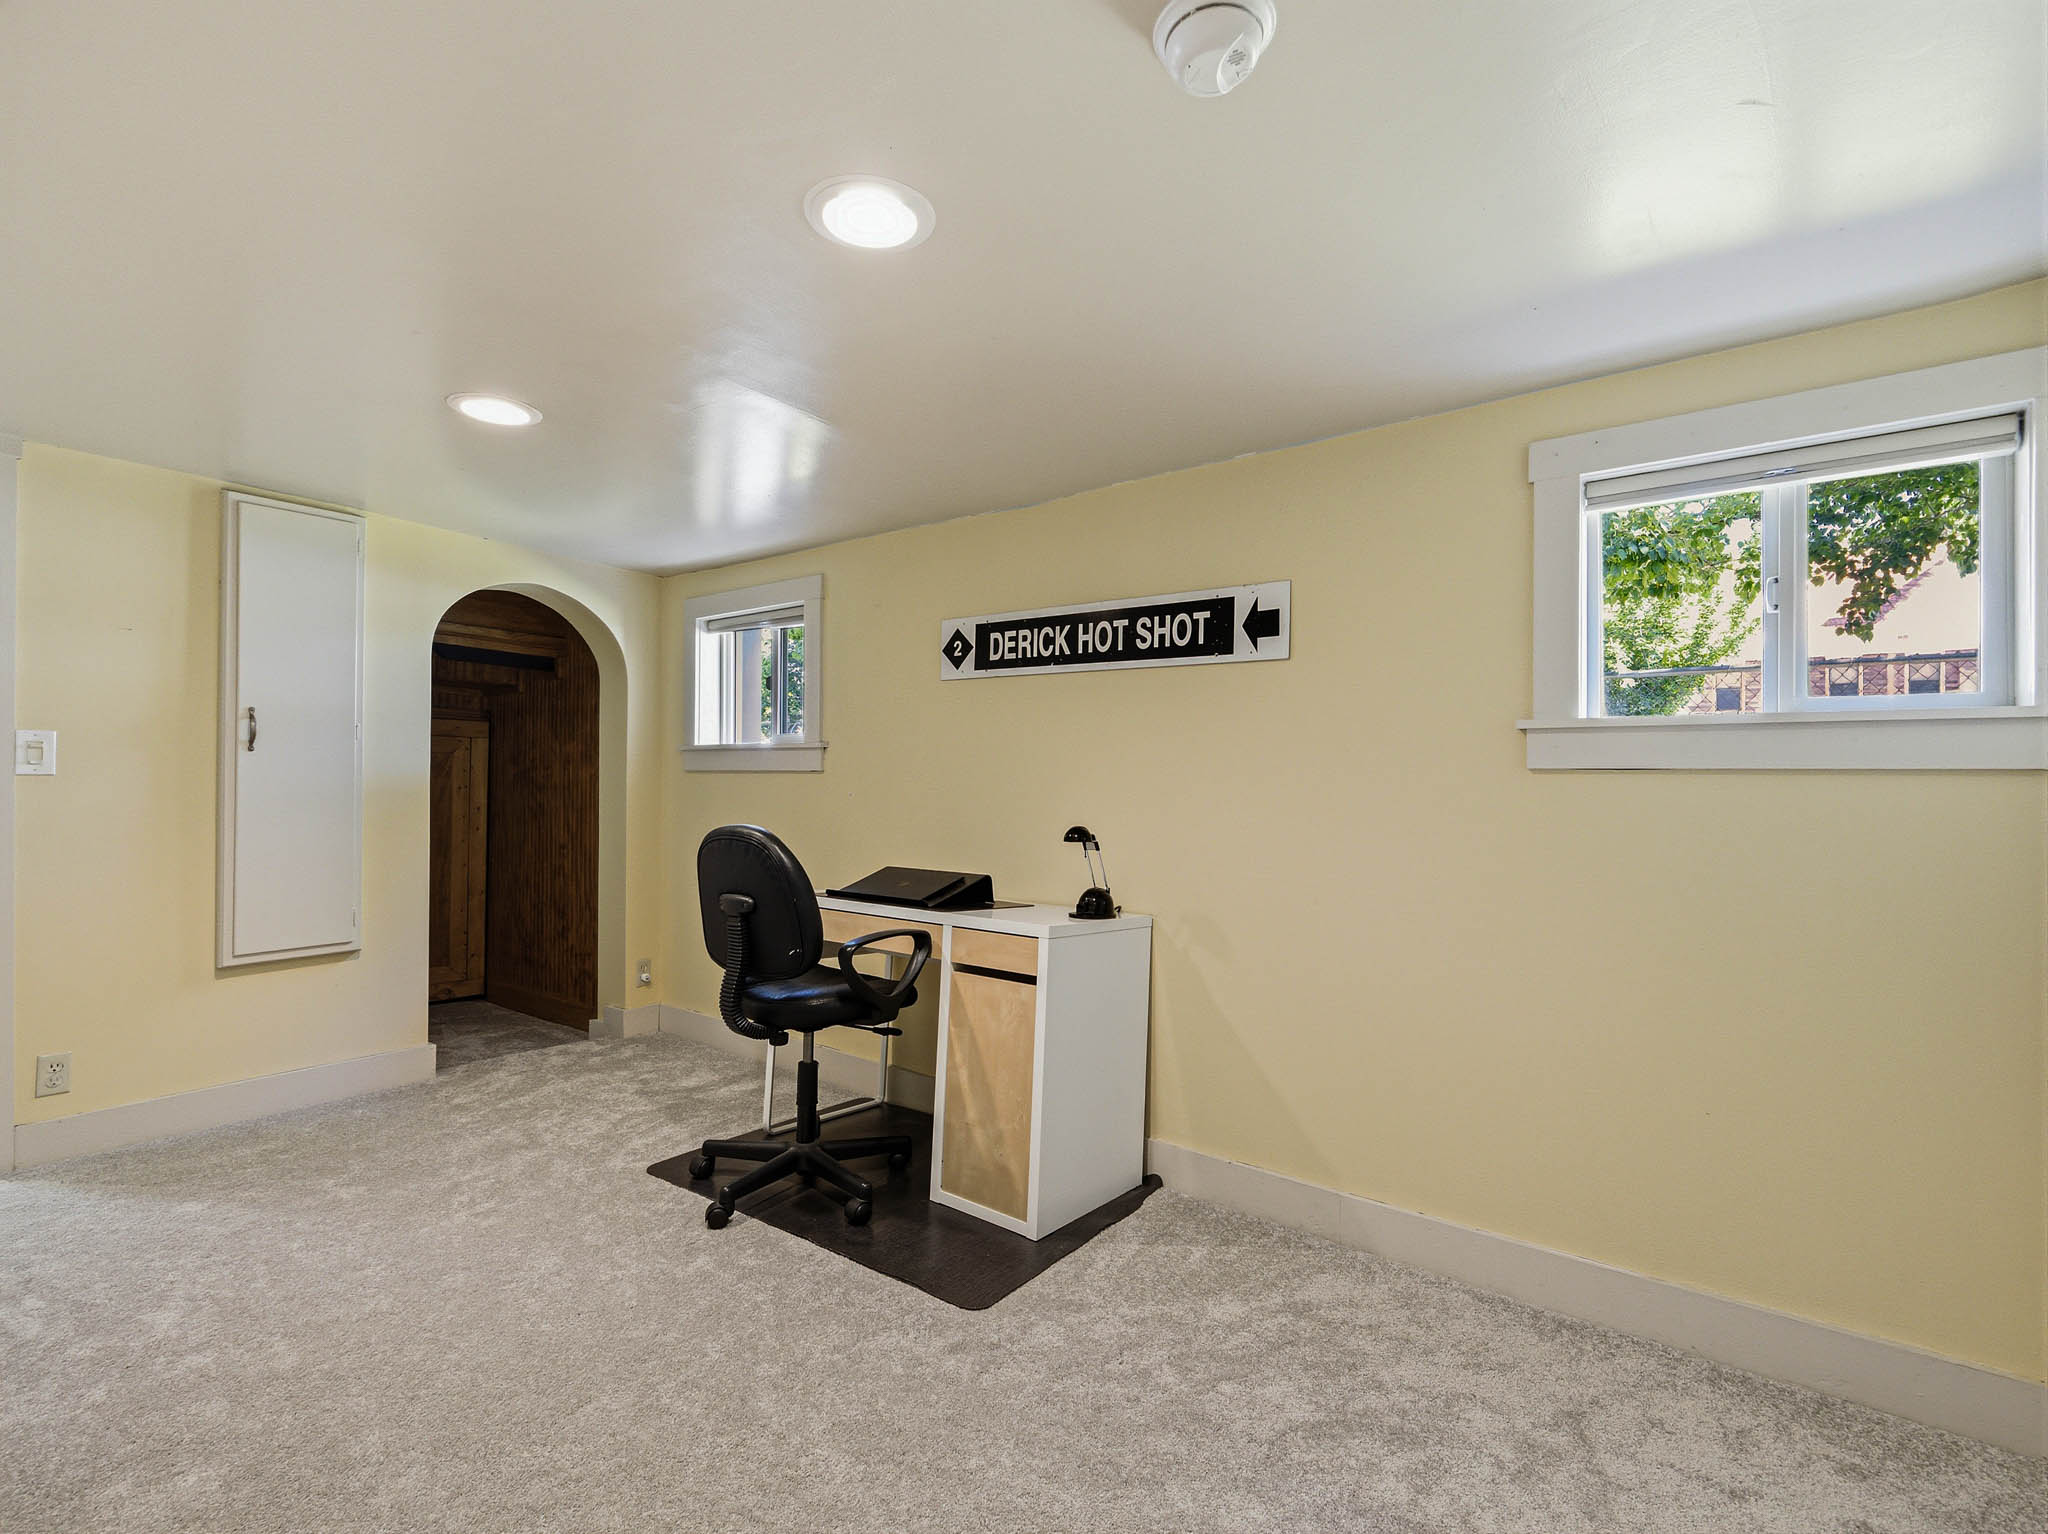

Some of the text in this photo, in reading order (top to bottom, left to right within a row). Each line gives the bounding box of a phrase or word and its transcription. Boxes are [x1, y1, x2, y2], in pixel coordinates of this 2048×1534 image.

[953, 610, 1211, 661] 2 DERICK HOT SHOT
